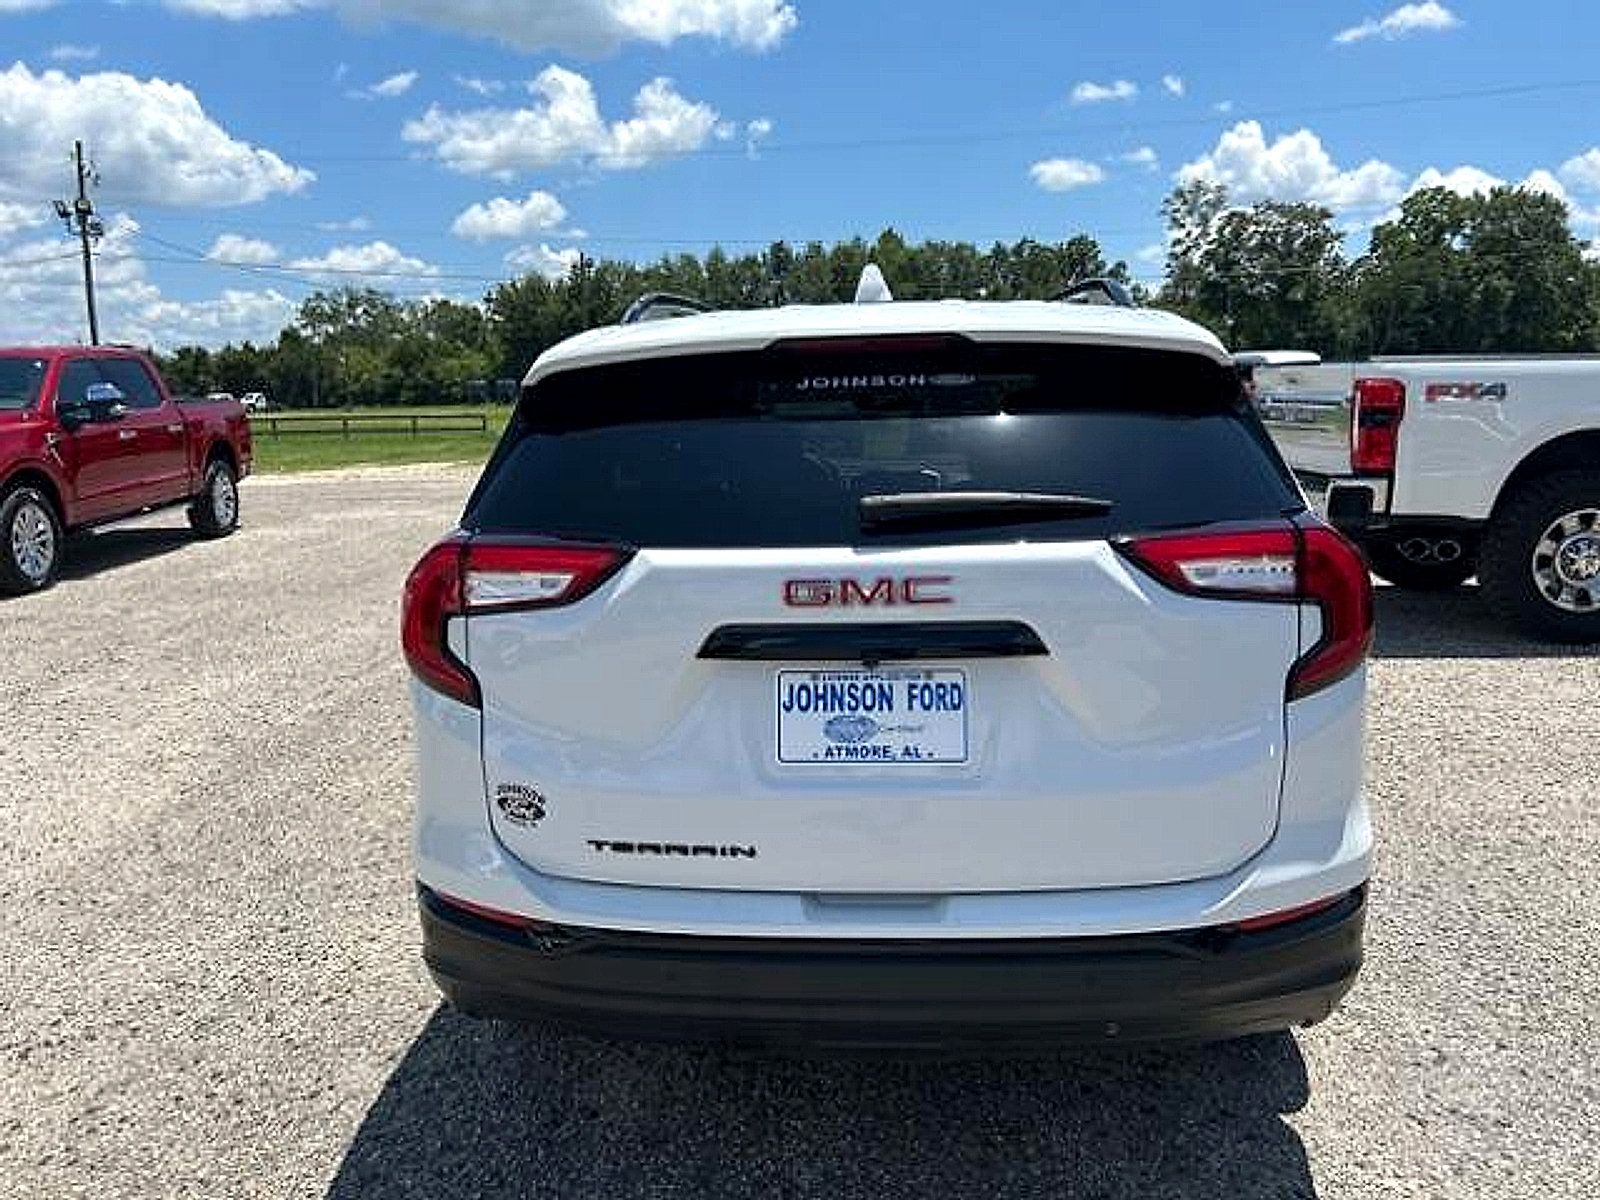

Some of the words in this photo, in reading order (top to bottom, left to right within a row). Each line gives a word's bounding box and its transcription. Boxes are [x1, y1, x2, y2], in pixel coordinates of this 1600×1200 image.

[796, 373, 925, 391] JOHNSON
[783, 575, 955, 607] GMC
[782, 682, 894, 713] JOHNSON
[907, 682, 962, 712] FORD
[901, 744, 922, 759] AL
[587, 839, 757, 858] TERRAIN
